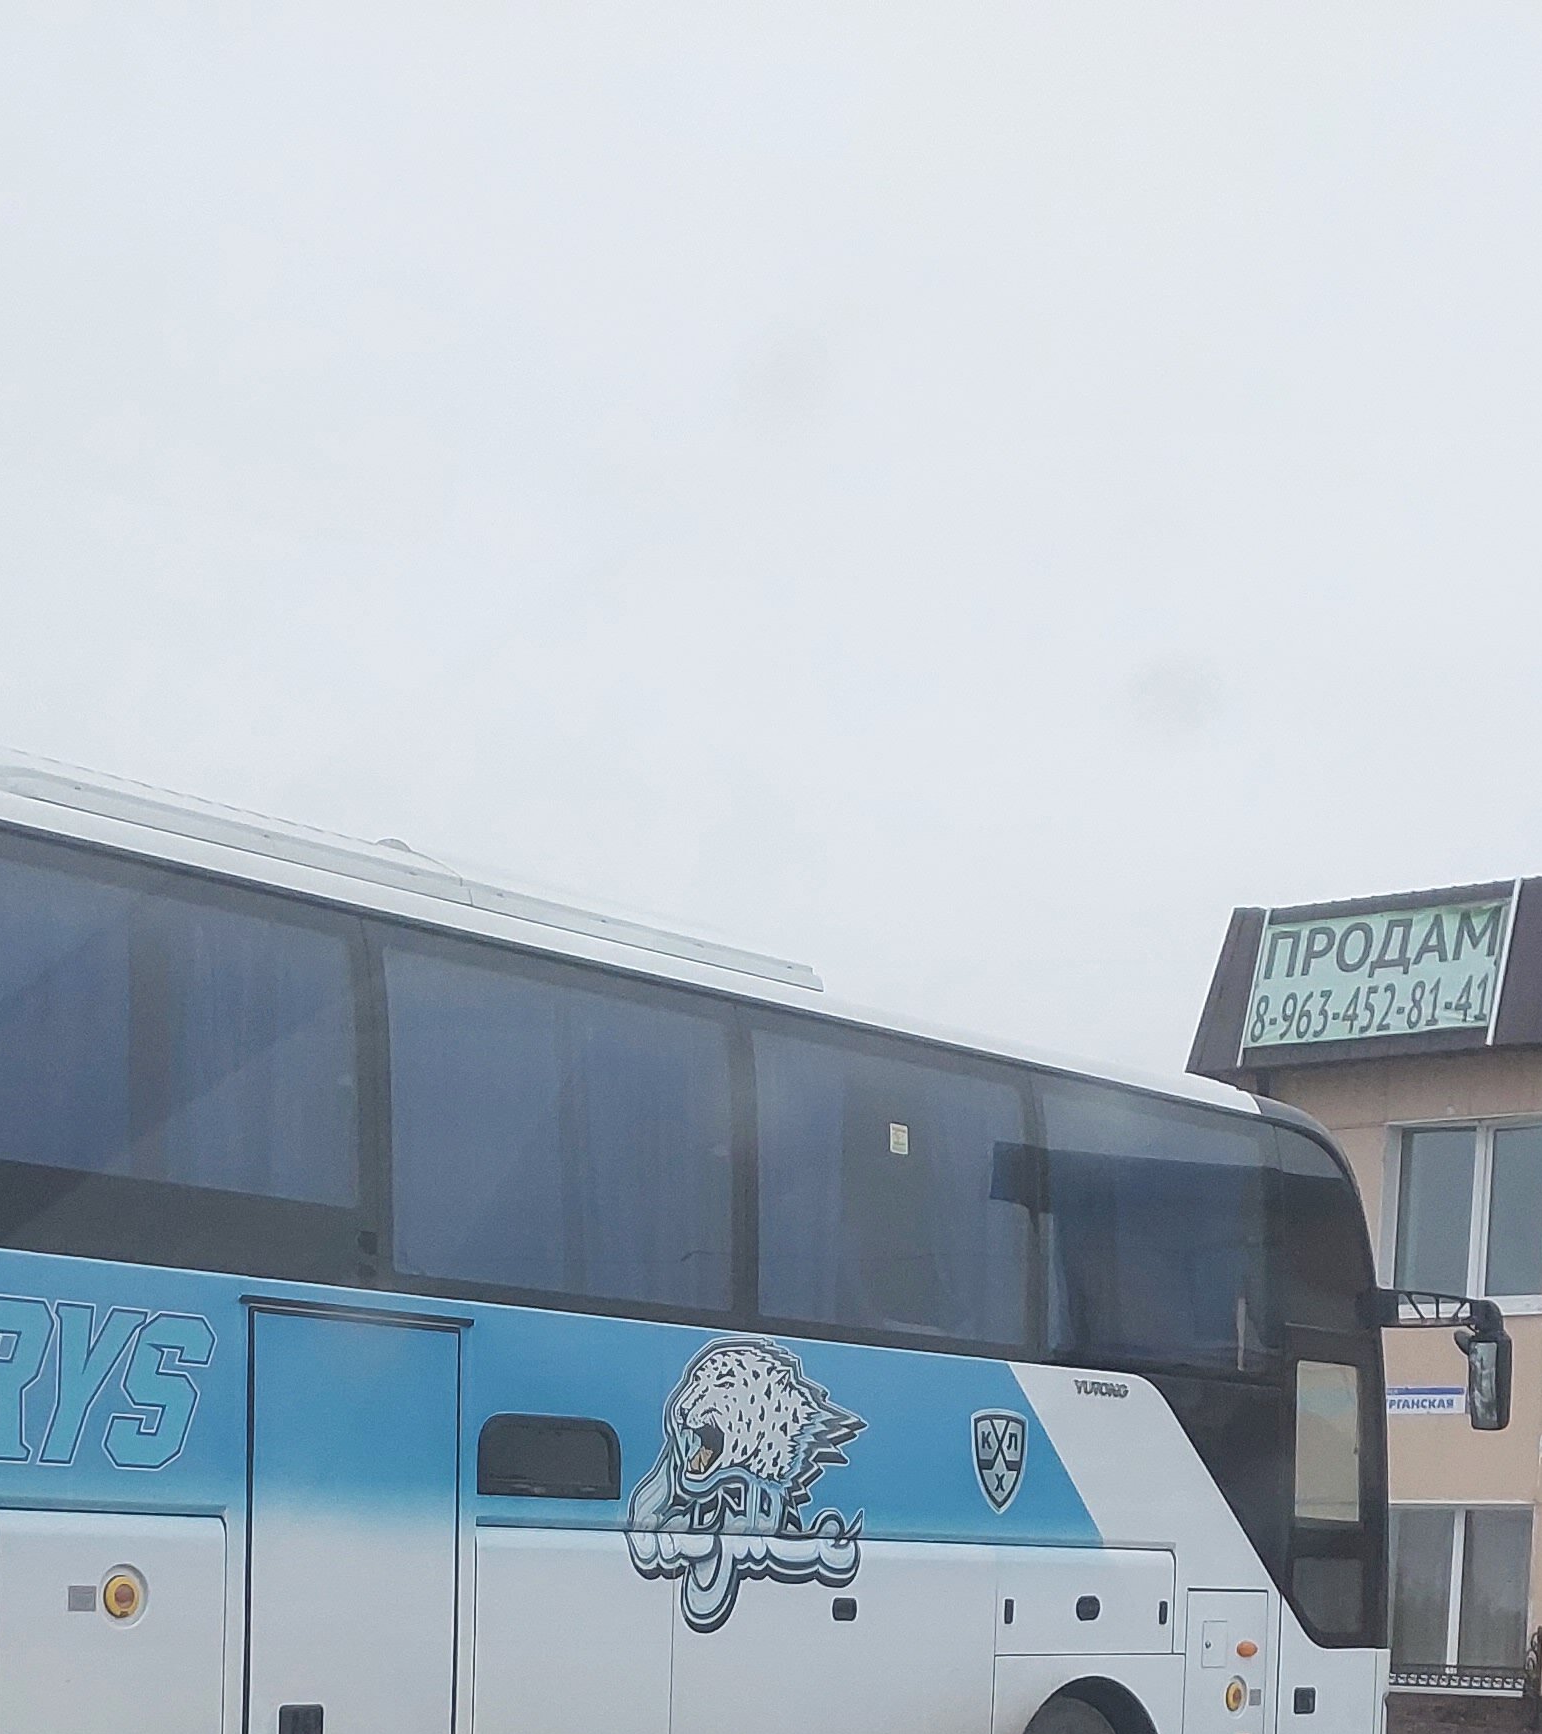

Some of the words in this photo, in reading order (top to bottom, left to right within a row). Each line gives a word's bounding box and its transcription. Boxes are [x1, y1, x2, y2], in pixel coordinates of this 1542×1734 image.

[1263, 905, 1503, 979] ПРОДАМ
[1249, 972, 1491, 1044] 8-963-452-81-41
[1073, 1379, 1130, 1398] YUTONG
